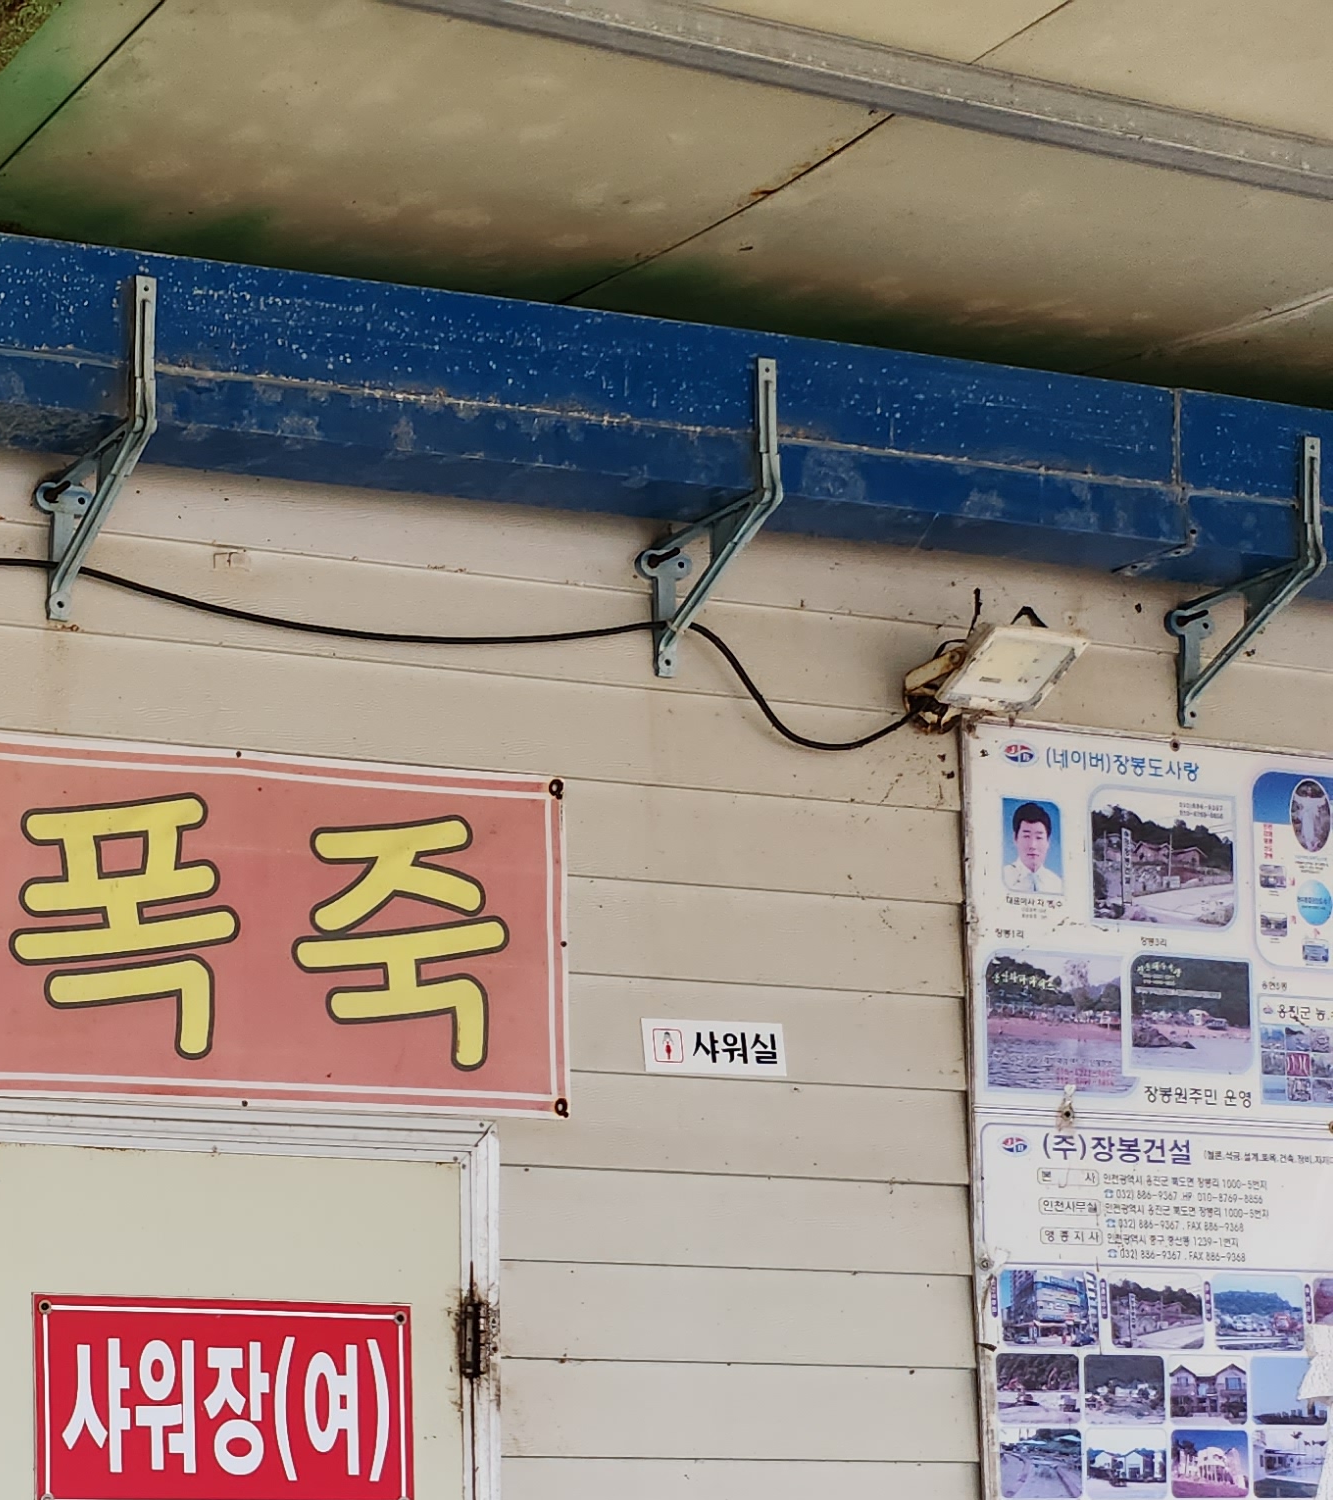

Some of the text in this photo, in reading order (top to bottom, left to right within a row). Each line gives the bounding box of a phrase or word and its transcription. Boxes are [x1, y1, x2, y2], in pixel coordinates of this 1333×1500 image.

[1045, 746, 1200, 782] (네이버)장봉도사랑
[692, 1030, 778, 1065] 샤워실
[1144, 1086, 1253, 1109] 장봉원주민 운영
[1042, 1132, 1192, 1165] (주)장봉건설
[1103, 1173, 1143, 1185] 인천광역시
[1043, 1200, 1098, 1214] 인천사무실
[1105, 1203, 1145, 1215] 인천광역시
[61, 1335, 391, 1482] 샤워장(여)
